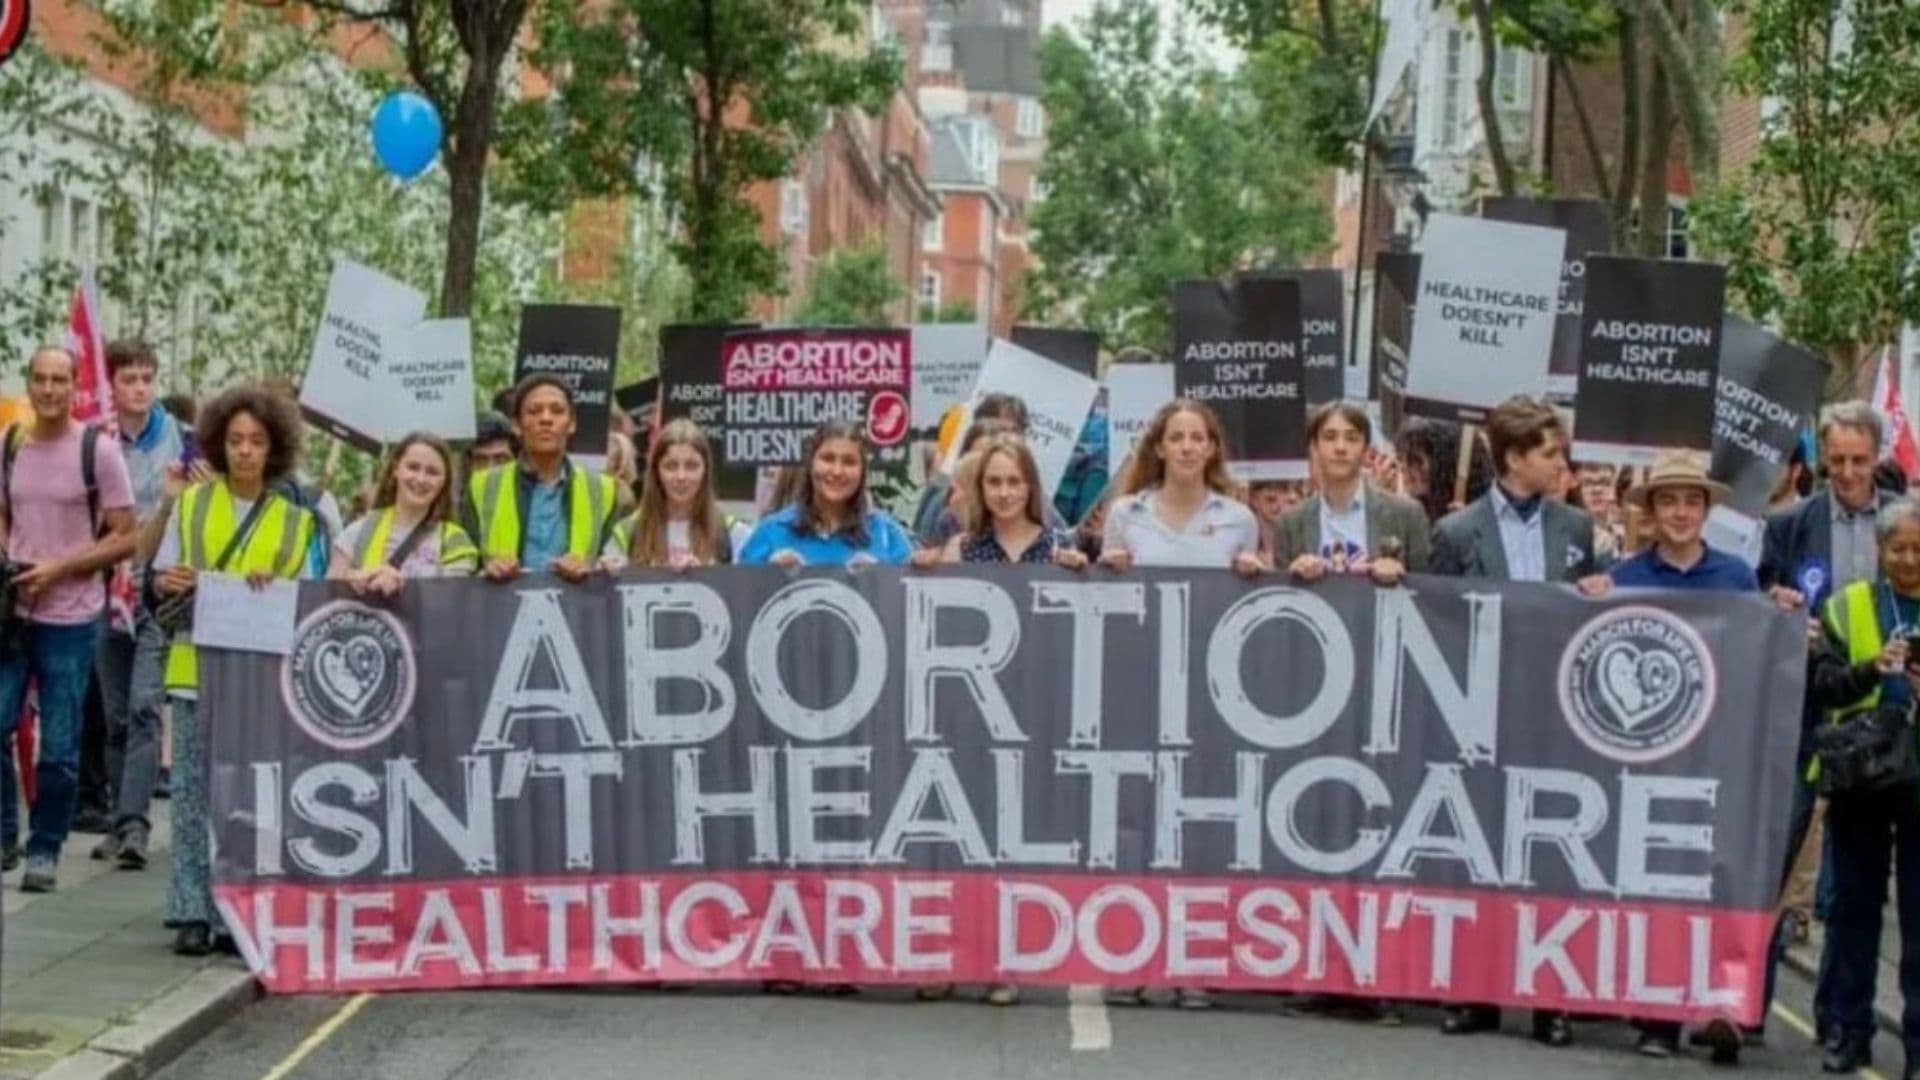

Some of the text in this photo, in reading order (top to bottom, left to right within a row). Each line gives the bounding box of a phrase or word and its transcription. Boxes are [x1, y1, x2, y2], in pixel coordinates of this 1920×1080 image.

[1425, 280, 1550, 313] HEALTHCARE
[1441, 303, 1528, 330] DOESN'T
[1459, 326, 1504, 348] KILL
[1592, 320, 1712, 347] ABORTION
[522, 353, 609, 371] ABORTION
[729, 341, 901, 368] ABORTION
[1185, 341, 1296, 361] ABORTION
[1621, 343, 1678, 365] ISN'T
[388, 359, 466, 374] HEALTHCARE
[726, 367, 904, 387] ISN'T HEALTHCARE
[1215, 363, 1268, 382] ISN'T
[1587, 362, 1710, 388] HEALTHCARE
[415, 389, 443, 401] KILL
[670, 384, 723, 401] ABORT
[1184, 382, 1299, 400] HEALTHCARE
[726, 391, 866, 423] HEALTHCARE
[473, 578, 1503, 766] ABORTION
[250, 741, 1721, 900] ISN'T HEALTHCARE
[253, 878, 1746, 1009] HEALTHCARE DOESN'T KILL
